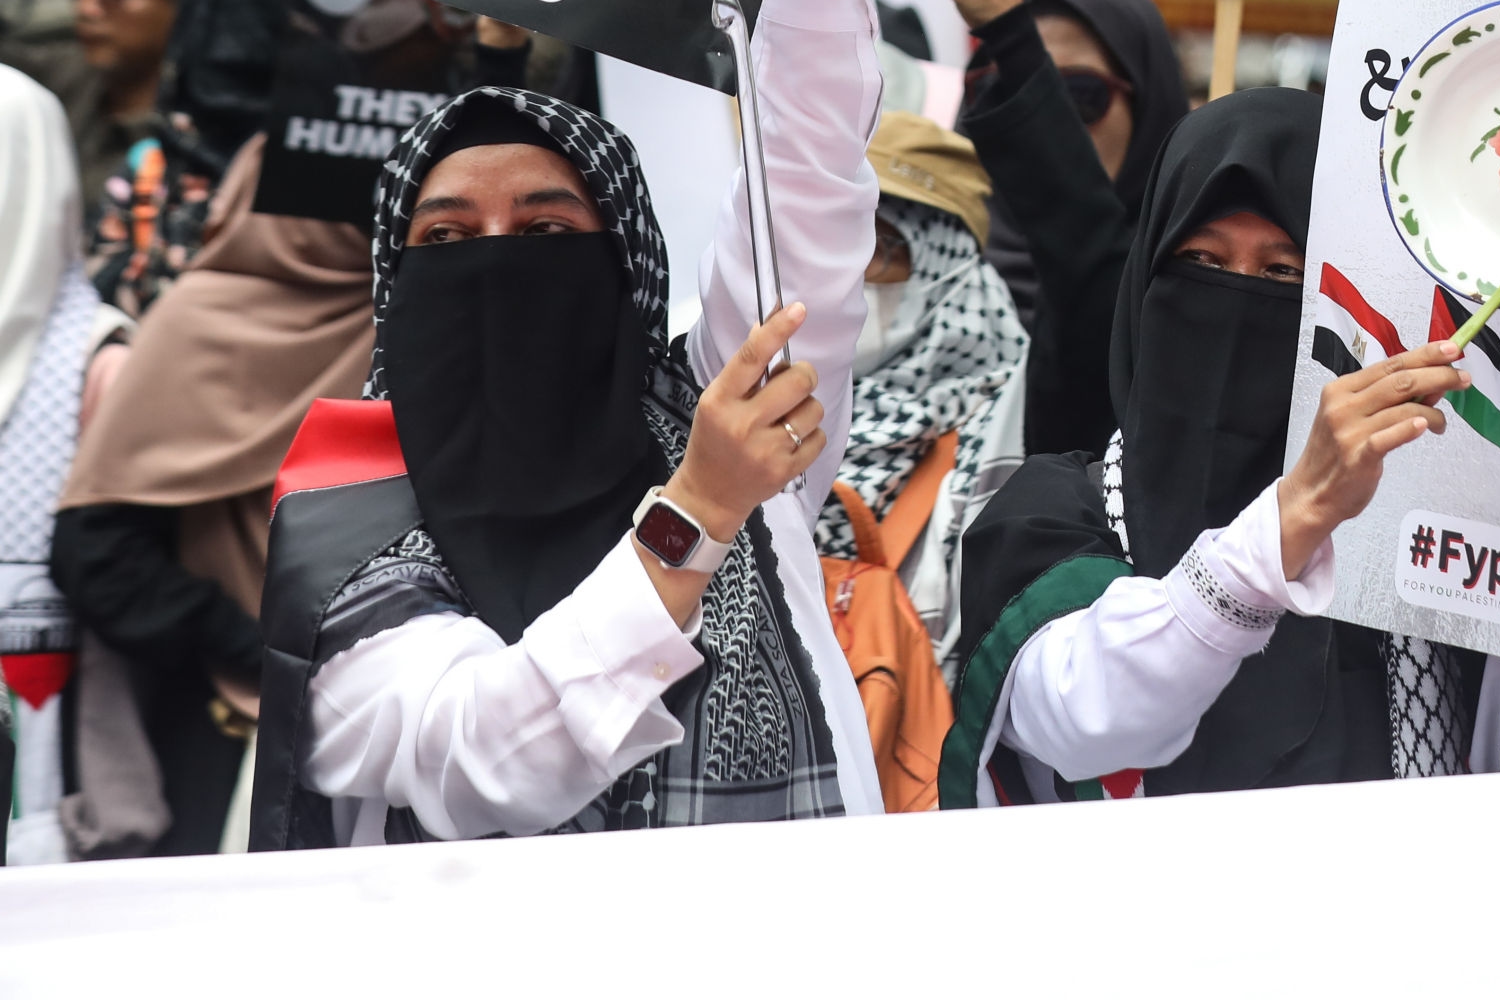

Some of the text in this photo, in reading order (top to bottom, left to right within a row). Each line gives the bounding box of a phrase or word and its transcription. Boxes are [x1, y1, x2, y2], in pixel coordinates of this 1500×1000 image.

[1403, 579, 1425, 592] FOR
[1428, 583, 1453, 598] YOU
[780, 666, 802, 719] ZETA
